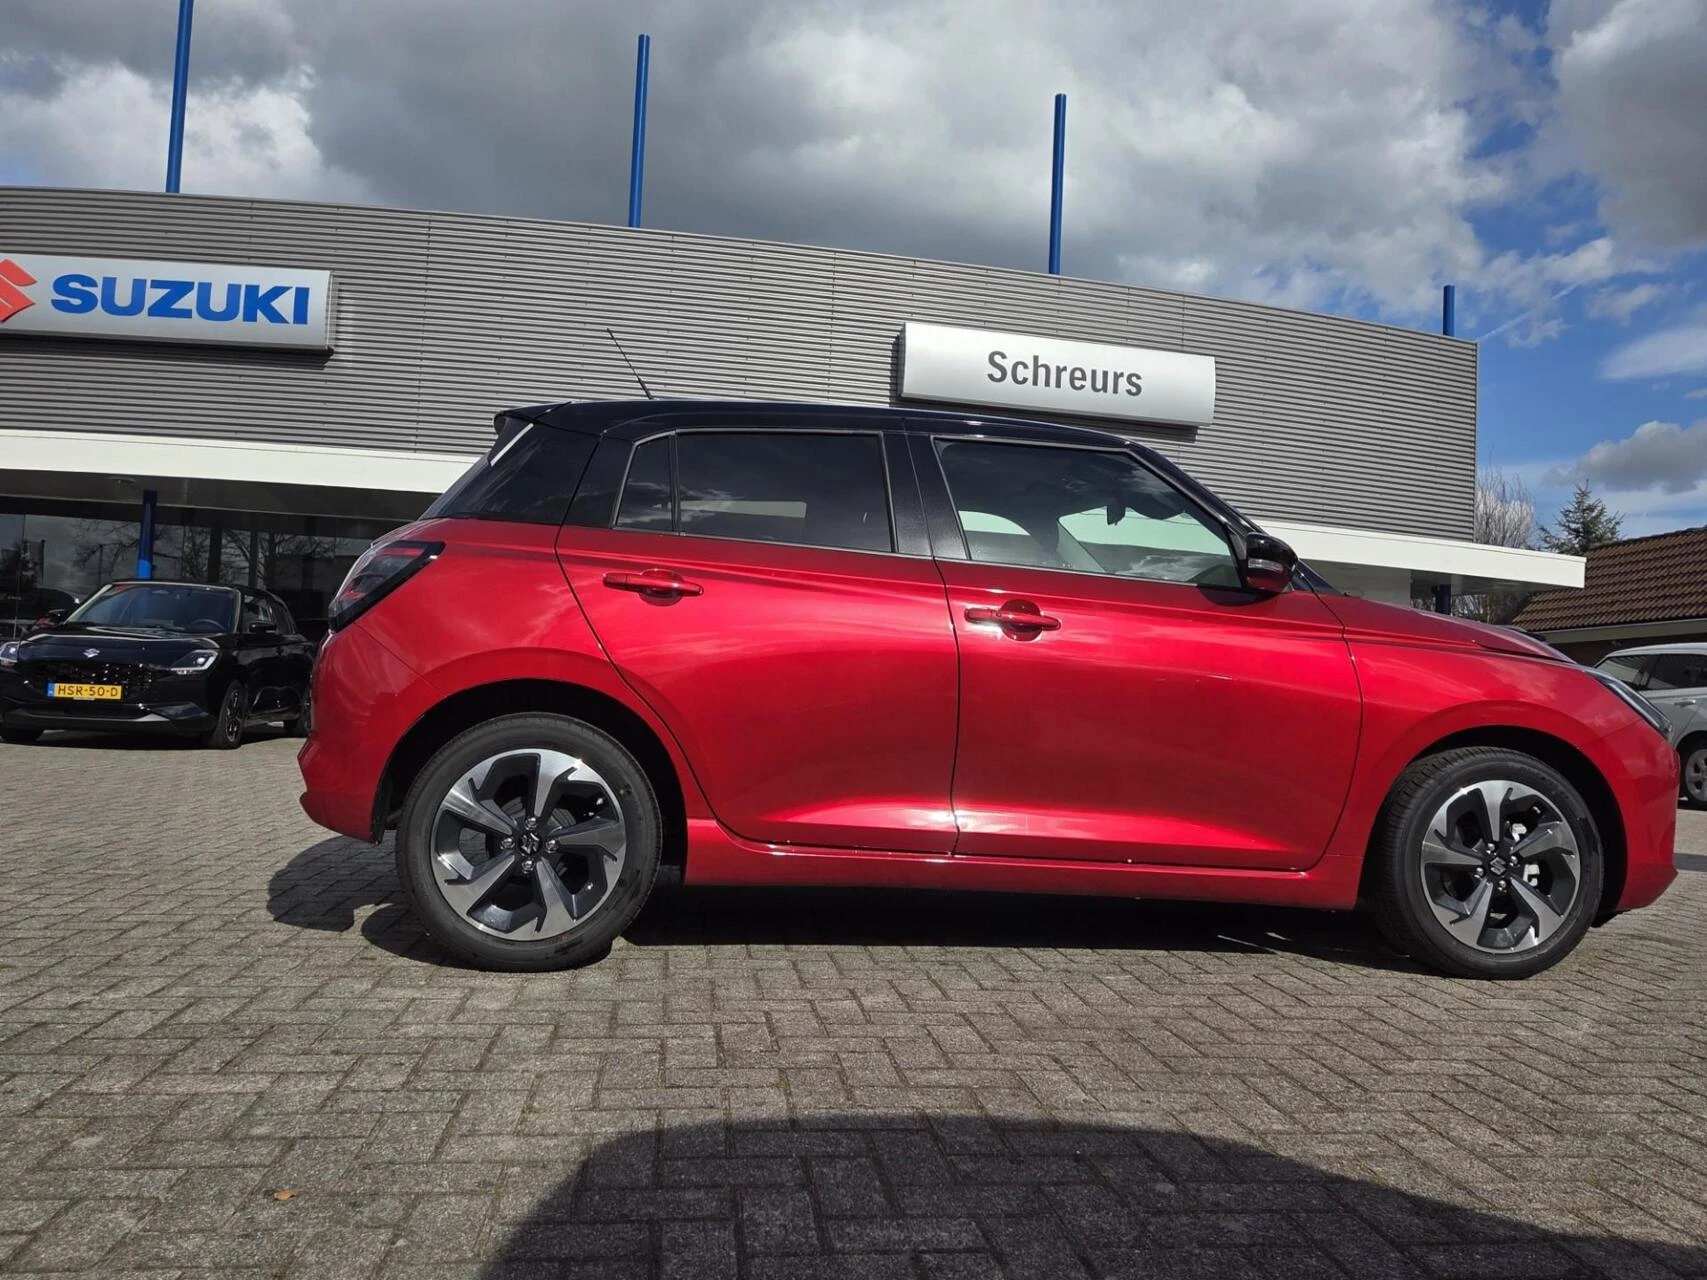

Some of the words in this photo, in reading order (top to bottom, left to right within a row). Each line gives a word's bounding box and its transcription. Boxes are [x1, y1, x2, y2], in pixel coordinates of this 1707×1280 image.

[51, 274, 310, 325] SUZUKI
[987, 350, 1143, 397] Schreurs
[57, 685, 118, 697] HSR-50-D
